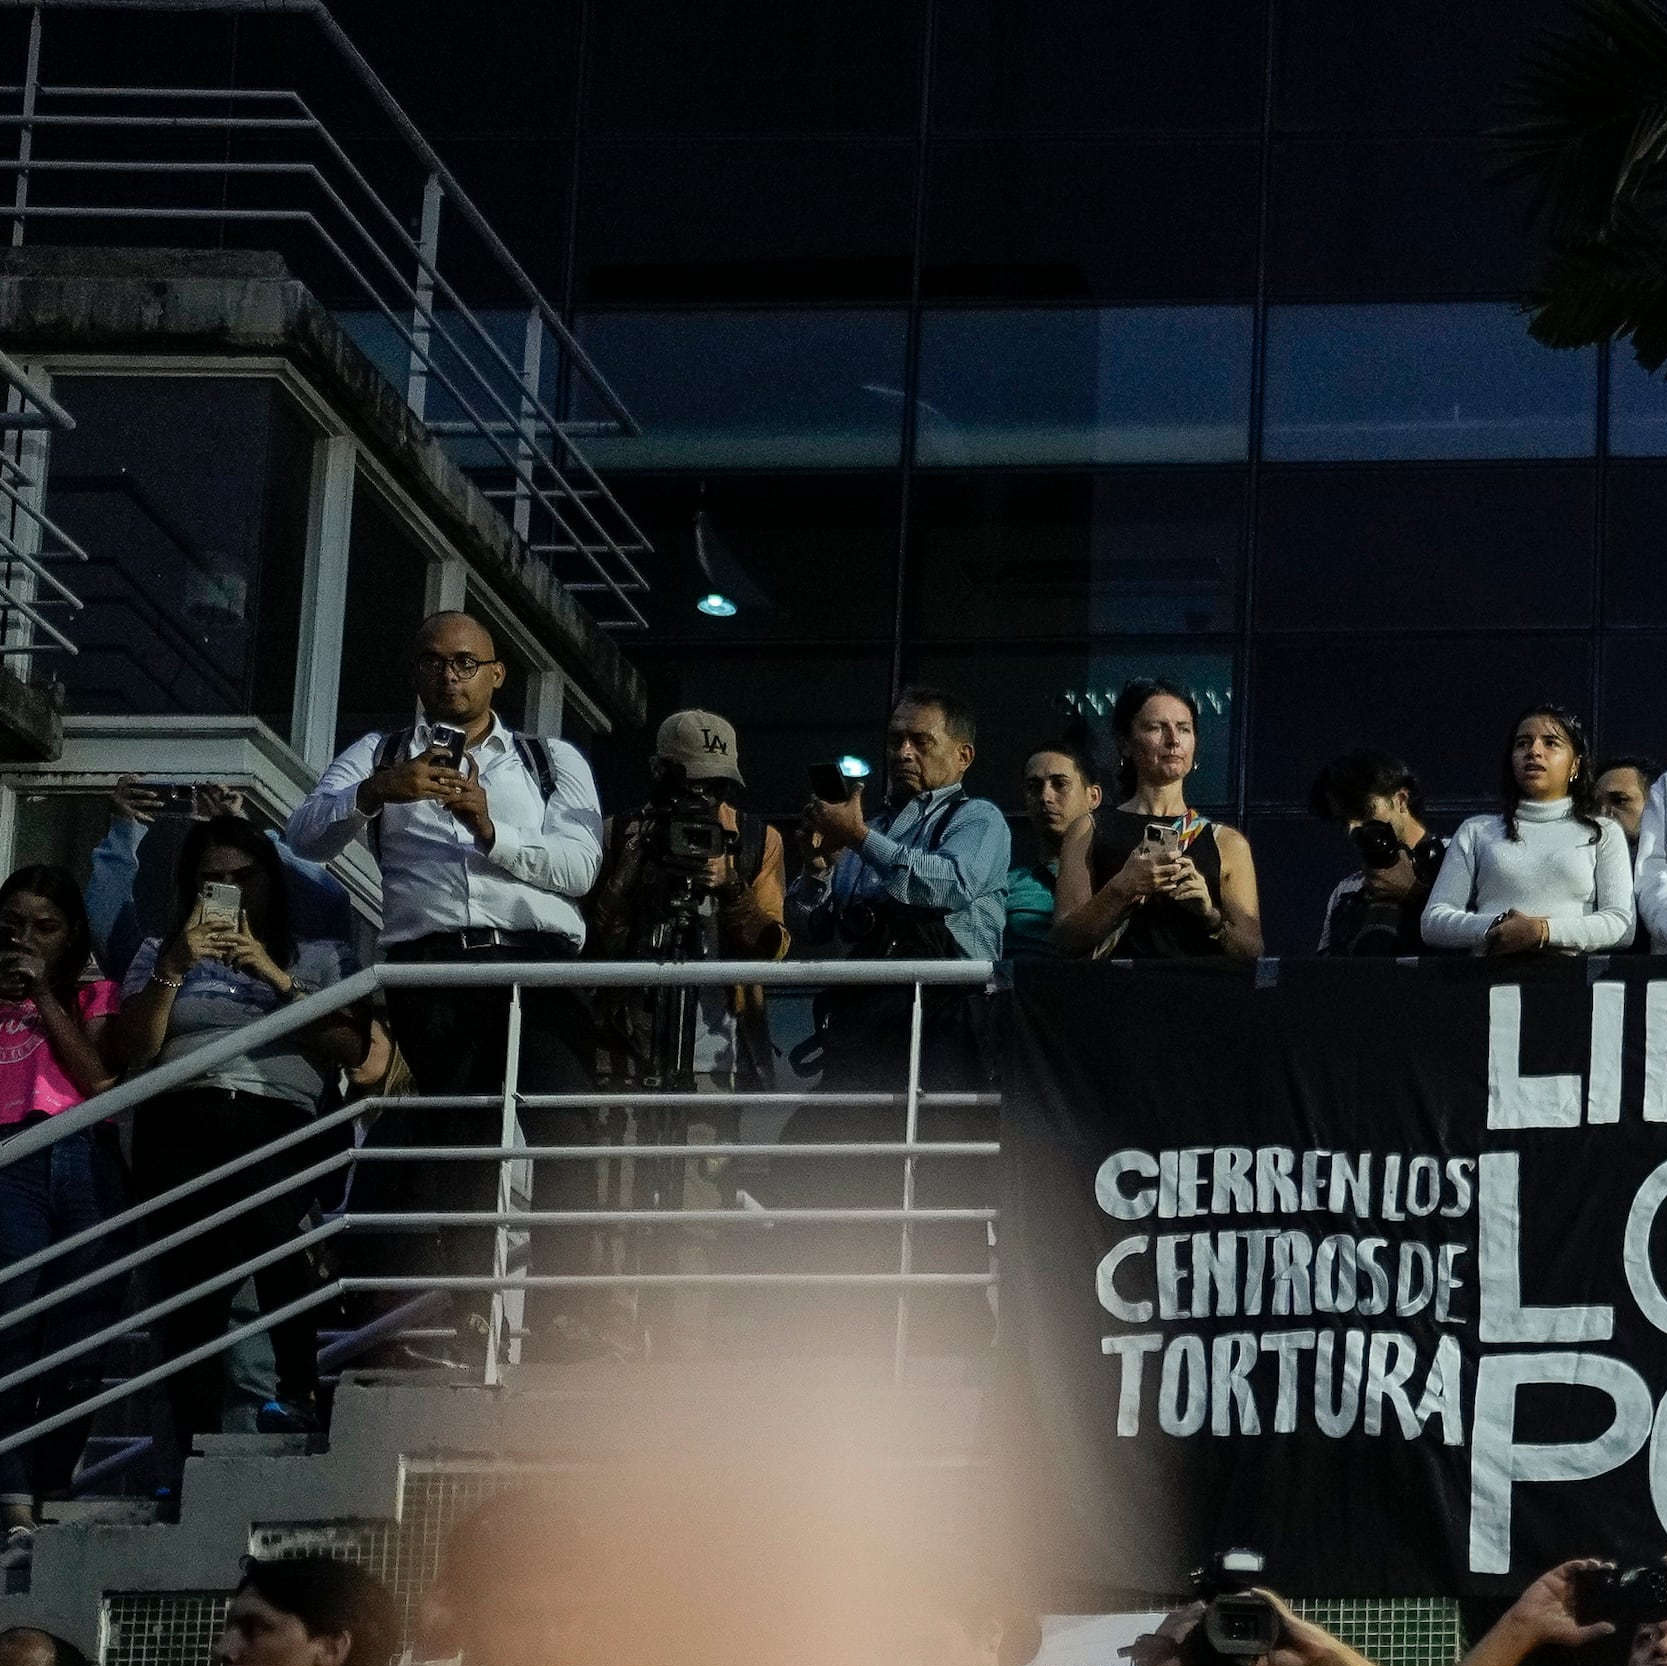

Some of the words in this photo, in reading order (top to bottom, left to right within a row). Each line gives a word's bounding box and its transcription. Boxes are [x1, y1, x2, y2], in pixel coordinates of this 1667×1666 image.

[700, 728, 728, 756] LA
[1095, 1147, 1386, 1221] CIERREN
[1386, 1153, 1478, 1222] LOS
[1095, 1227, 1389, 1324] CENTROS
[1396, 1240, 1468, 1326] DE
[1101, 1329, 1465, 1447] TORTURA
